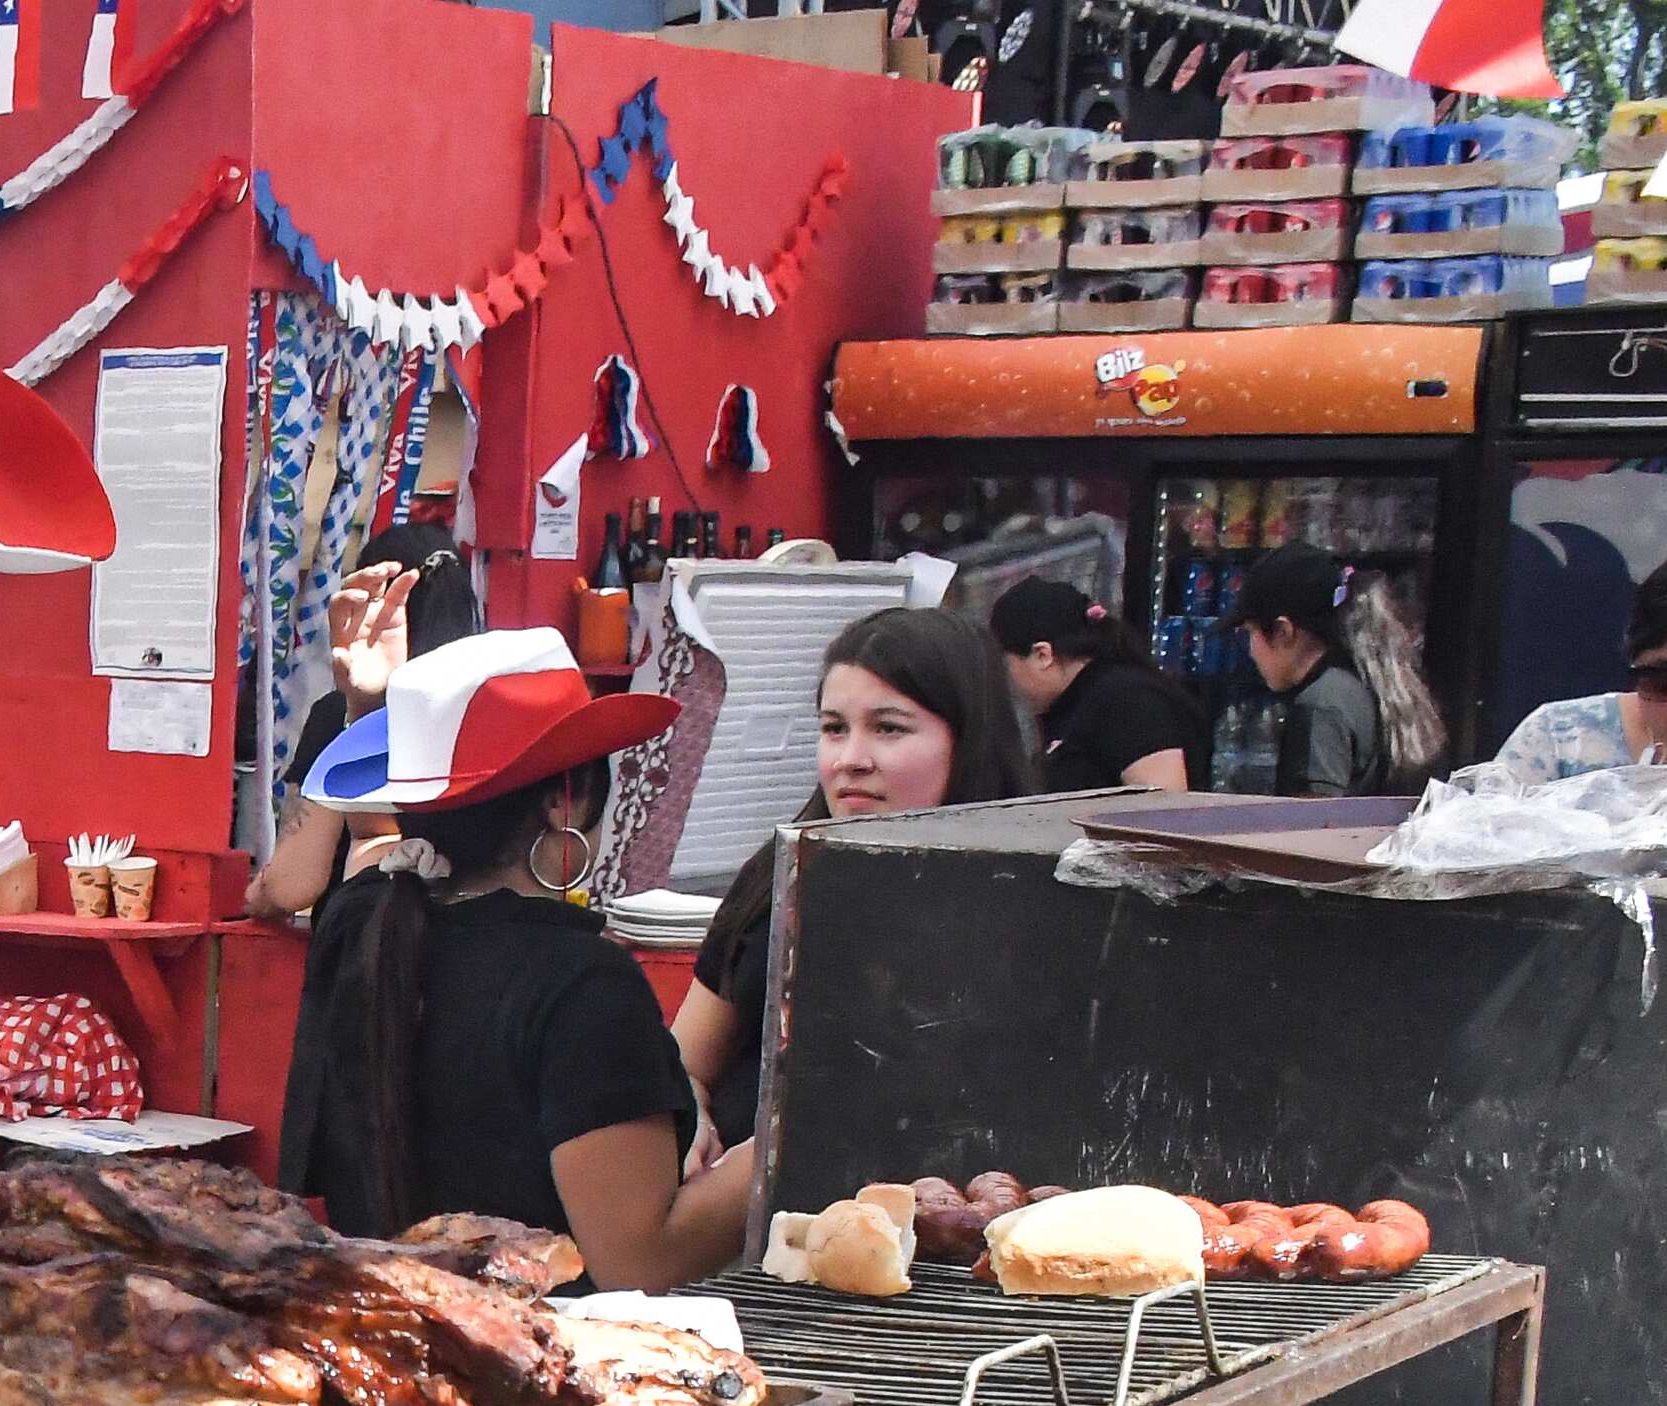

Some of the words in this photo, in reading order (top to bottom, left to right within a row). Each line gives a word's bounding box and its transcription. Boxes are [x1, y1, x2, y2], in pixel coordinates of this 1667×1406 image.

[1096, 349, 1145, 382] Bilz
[404, 386, 432, 466] Chile
[380, 433, 405, 495] Viva
